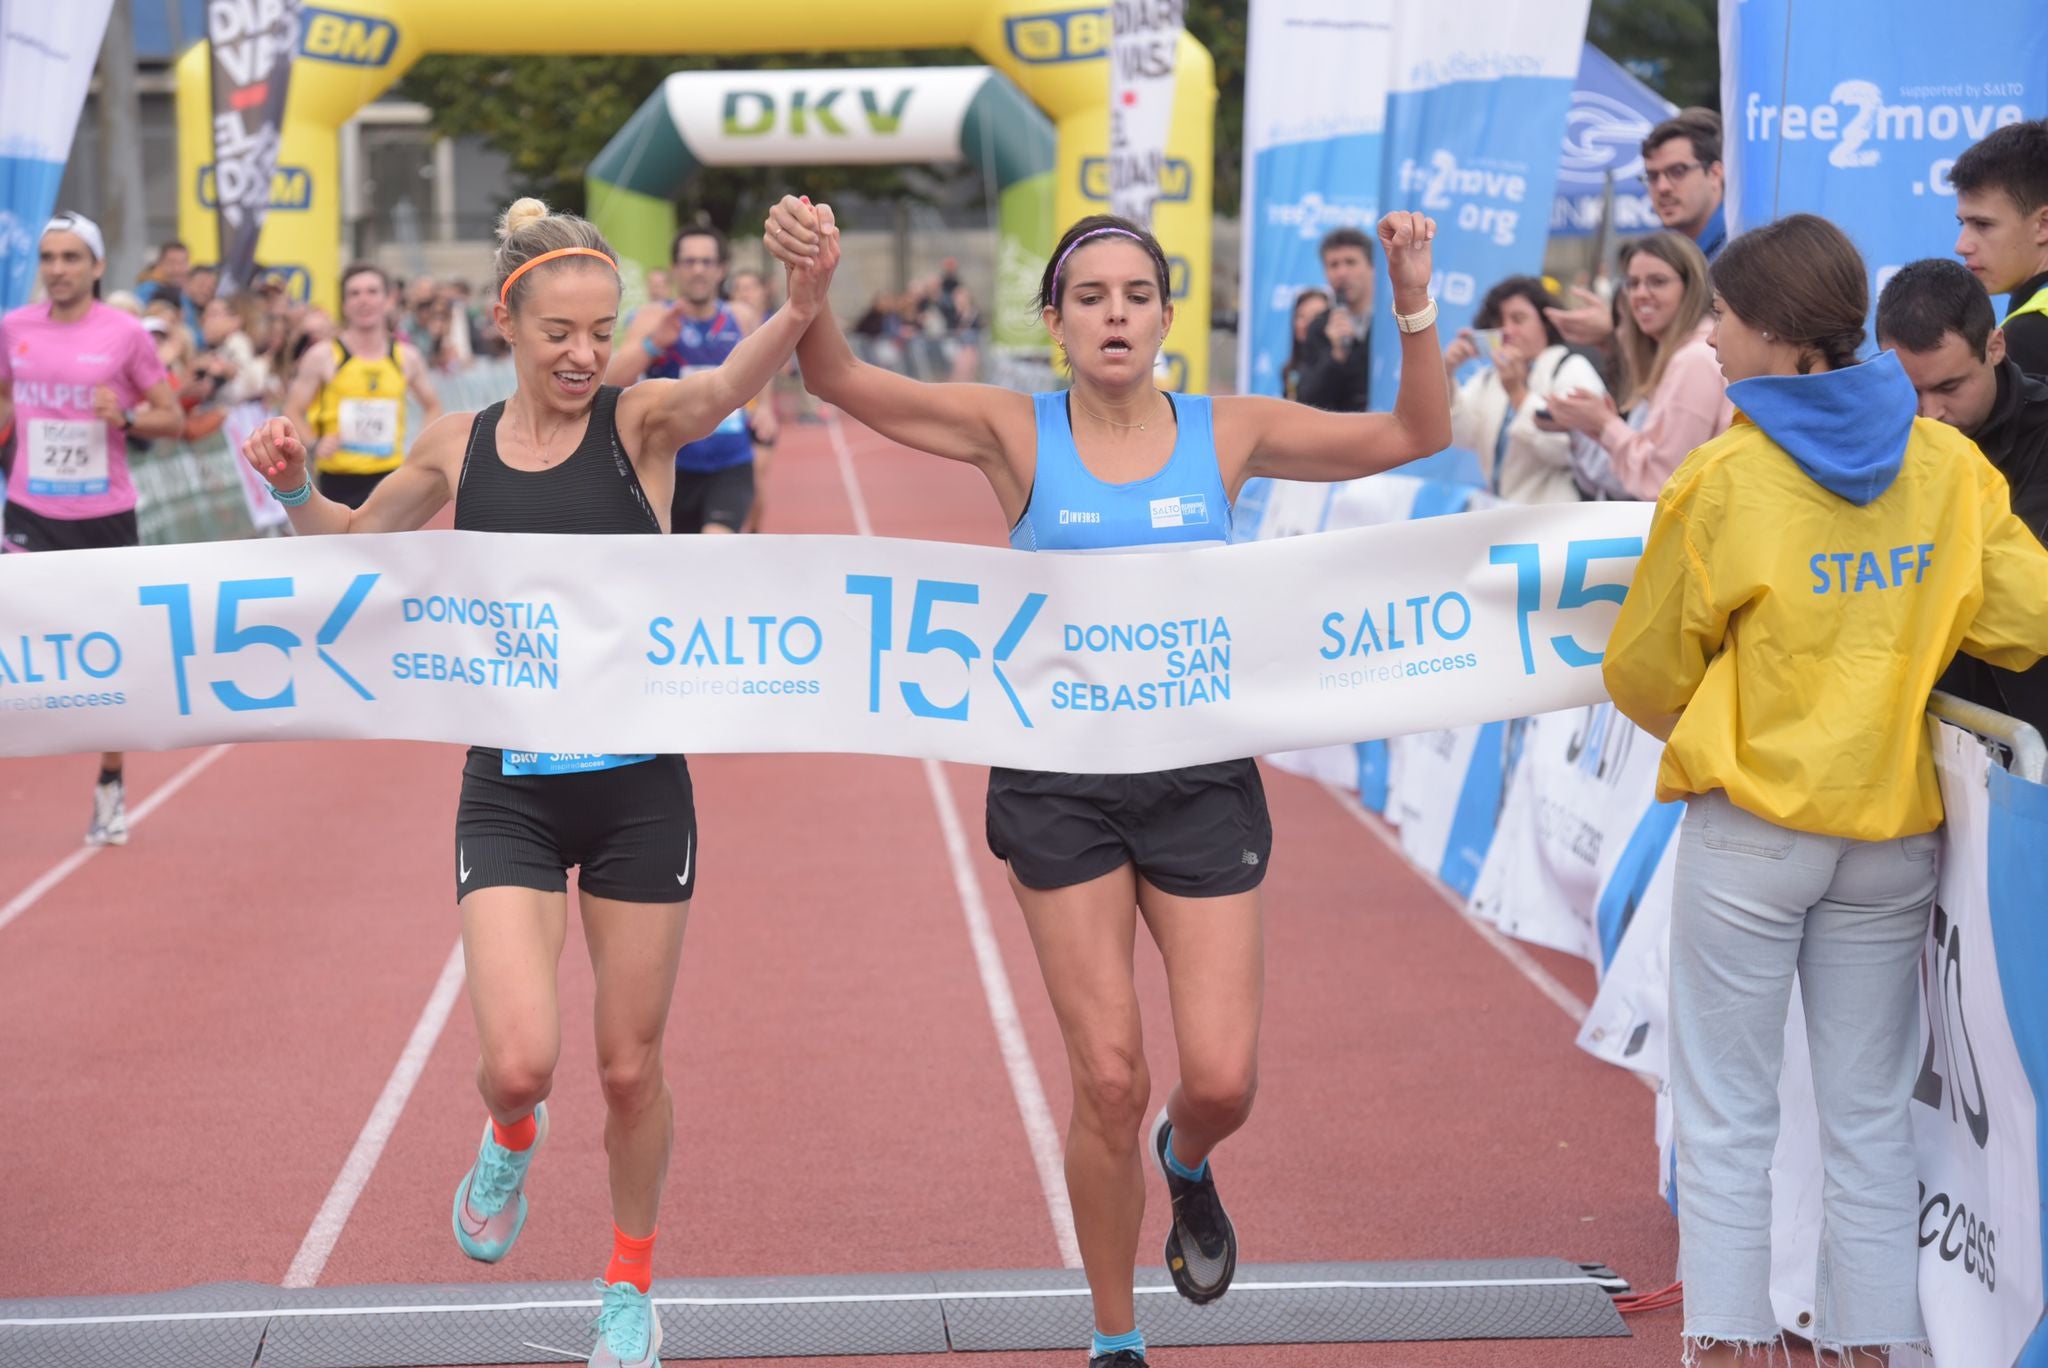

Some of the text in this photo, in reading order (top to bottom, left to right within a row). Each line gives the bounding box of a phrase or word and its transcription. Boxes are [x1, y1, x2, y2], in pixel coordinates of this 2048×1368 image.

[304, 14, 391, 63] BM
[723, 86, 914, 136] DKV
[1900, 82, 2024, 99] supported by SALTO
[1746, 79, 2023, 168] free2move
[44, 445, 90, 467] 275
[1152, 504, 1180, 516] SALTO
[1809, 543, 1935, 595] STAFF
[402, 596, 560, 630] DONOSTIA
[1319, 591, 1472, 661] SALTO
[1489, 536, 1644, 675] 15
[138, 573, 381, 716] 15K
[494, 630, 560, 661] SAN
[645, 616, 823, 669] SALTO
[845, 574, 1049, 728] 15K
[1064, 615, 1232, 653] DONOSTIA
[0, 631, 123, 686] LTO
[391, 652, 560, 690] SEBASTIAN
[1166, 645, 1232, 679] SAN
[1050, 674, 1232, 713] SEBASTIAN
[511, 753, 538, 764] DKV
